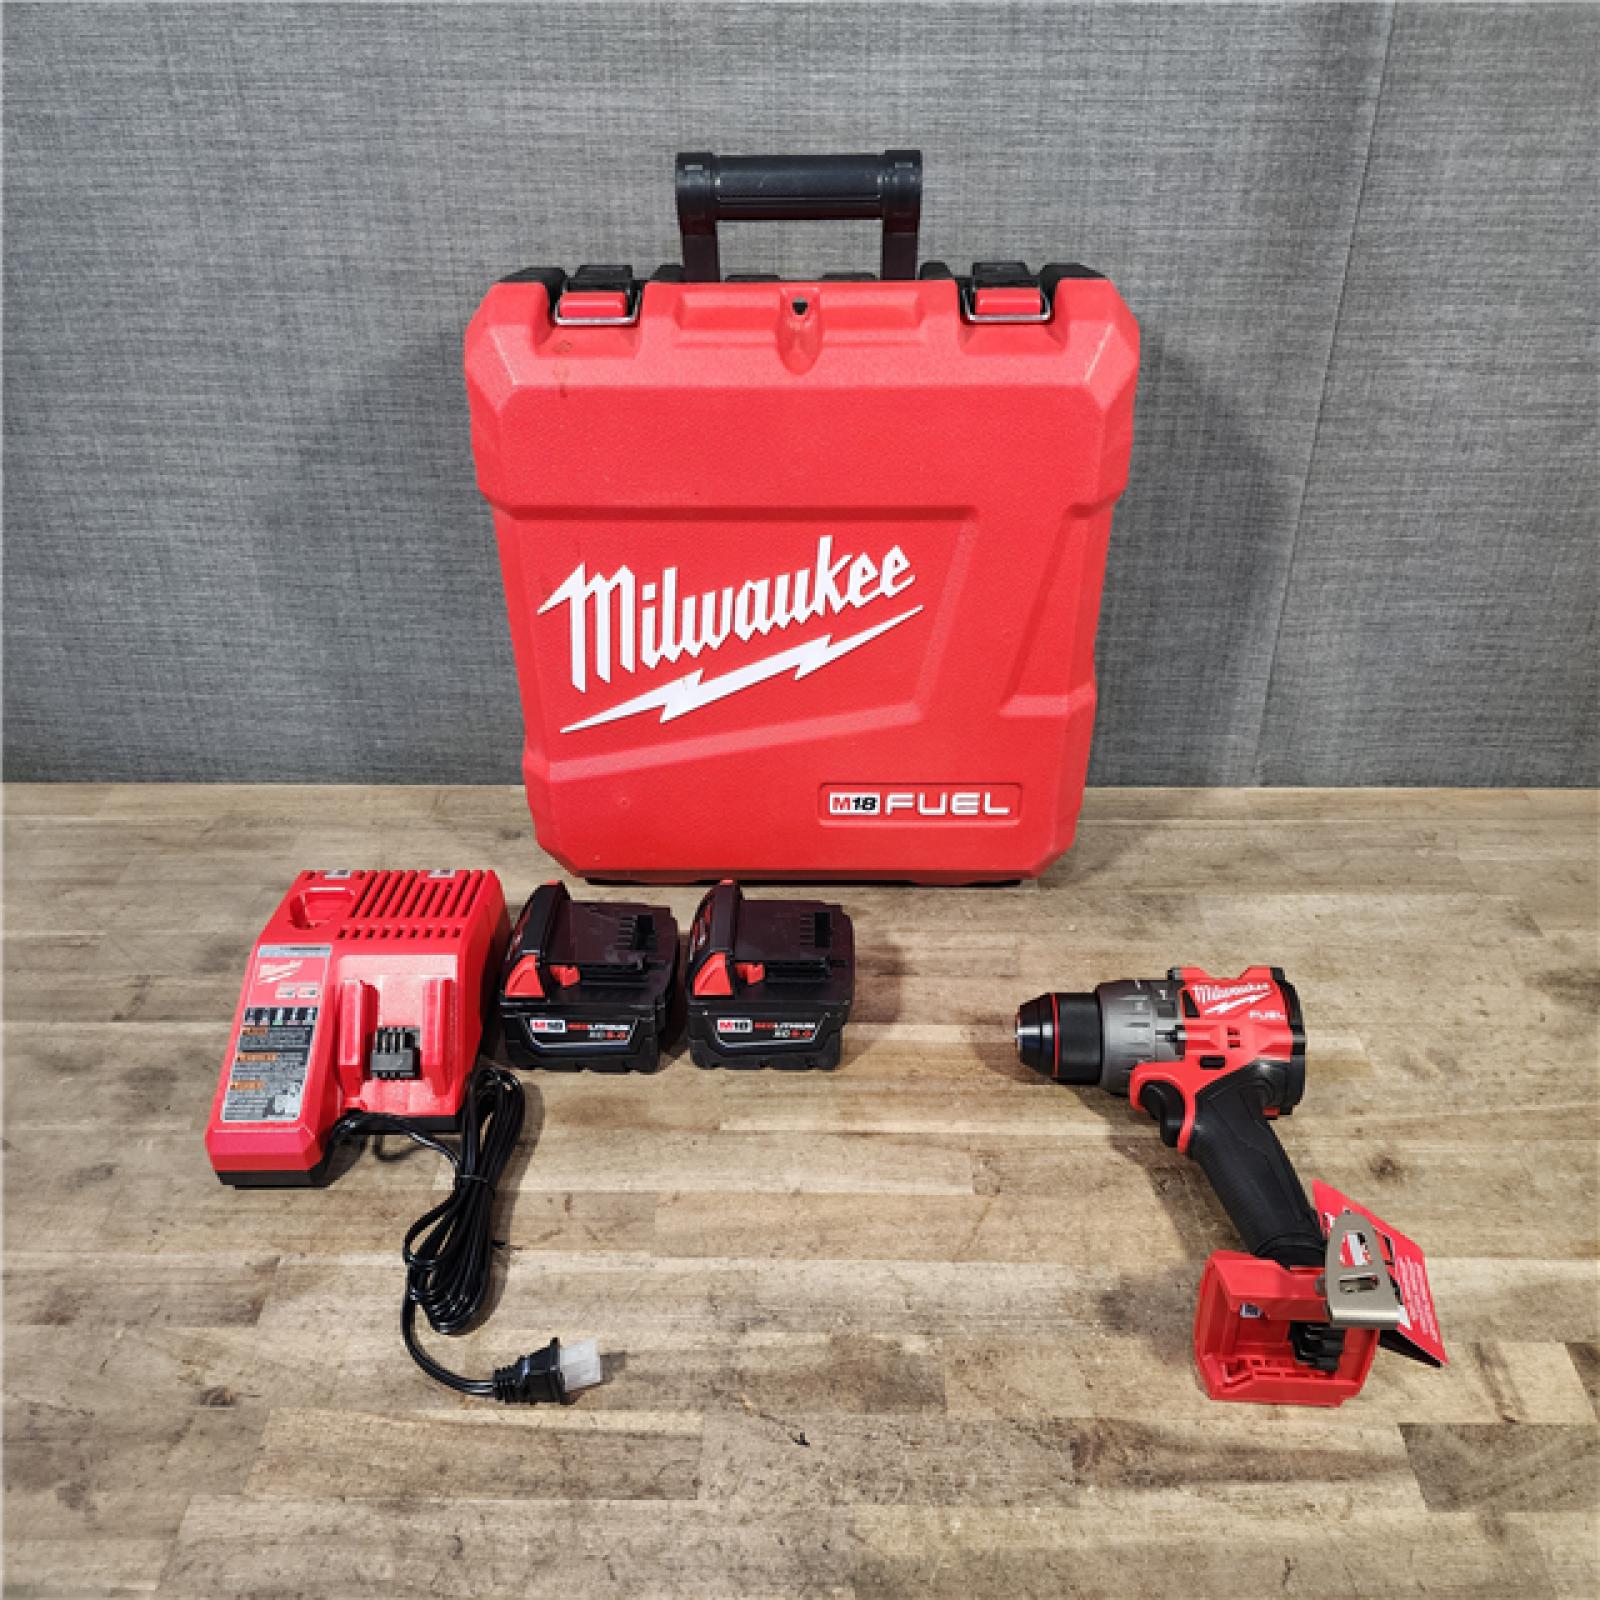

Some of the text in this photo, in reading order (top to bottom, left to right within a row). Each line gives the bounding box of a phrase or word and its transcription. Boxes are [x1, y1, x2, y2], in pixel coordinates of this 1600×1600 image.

[536, 535, 916, 693] Milwaukee
[832, 791, 1011, 816] M18 FUEL
